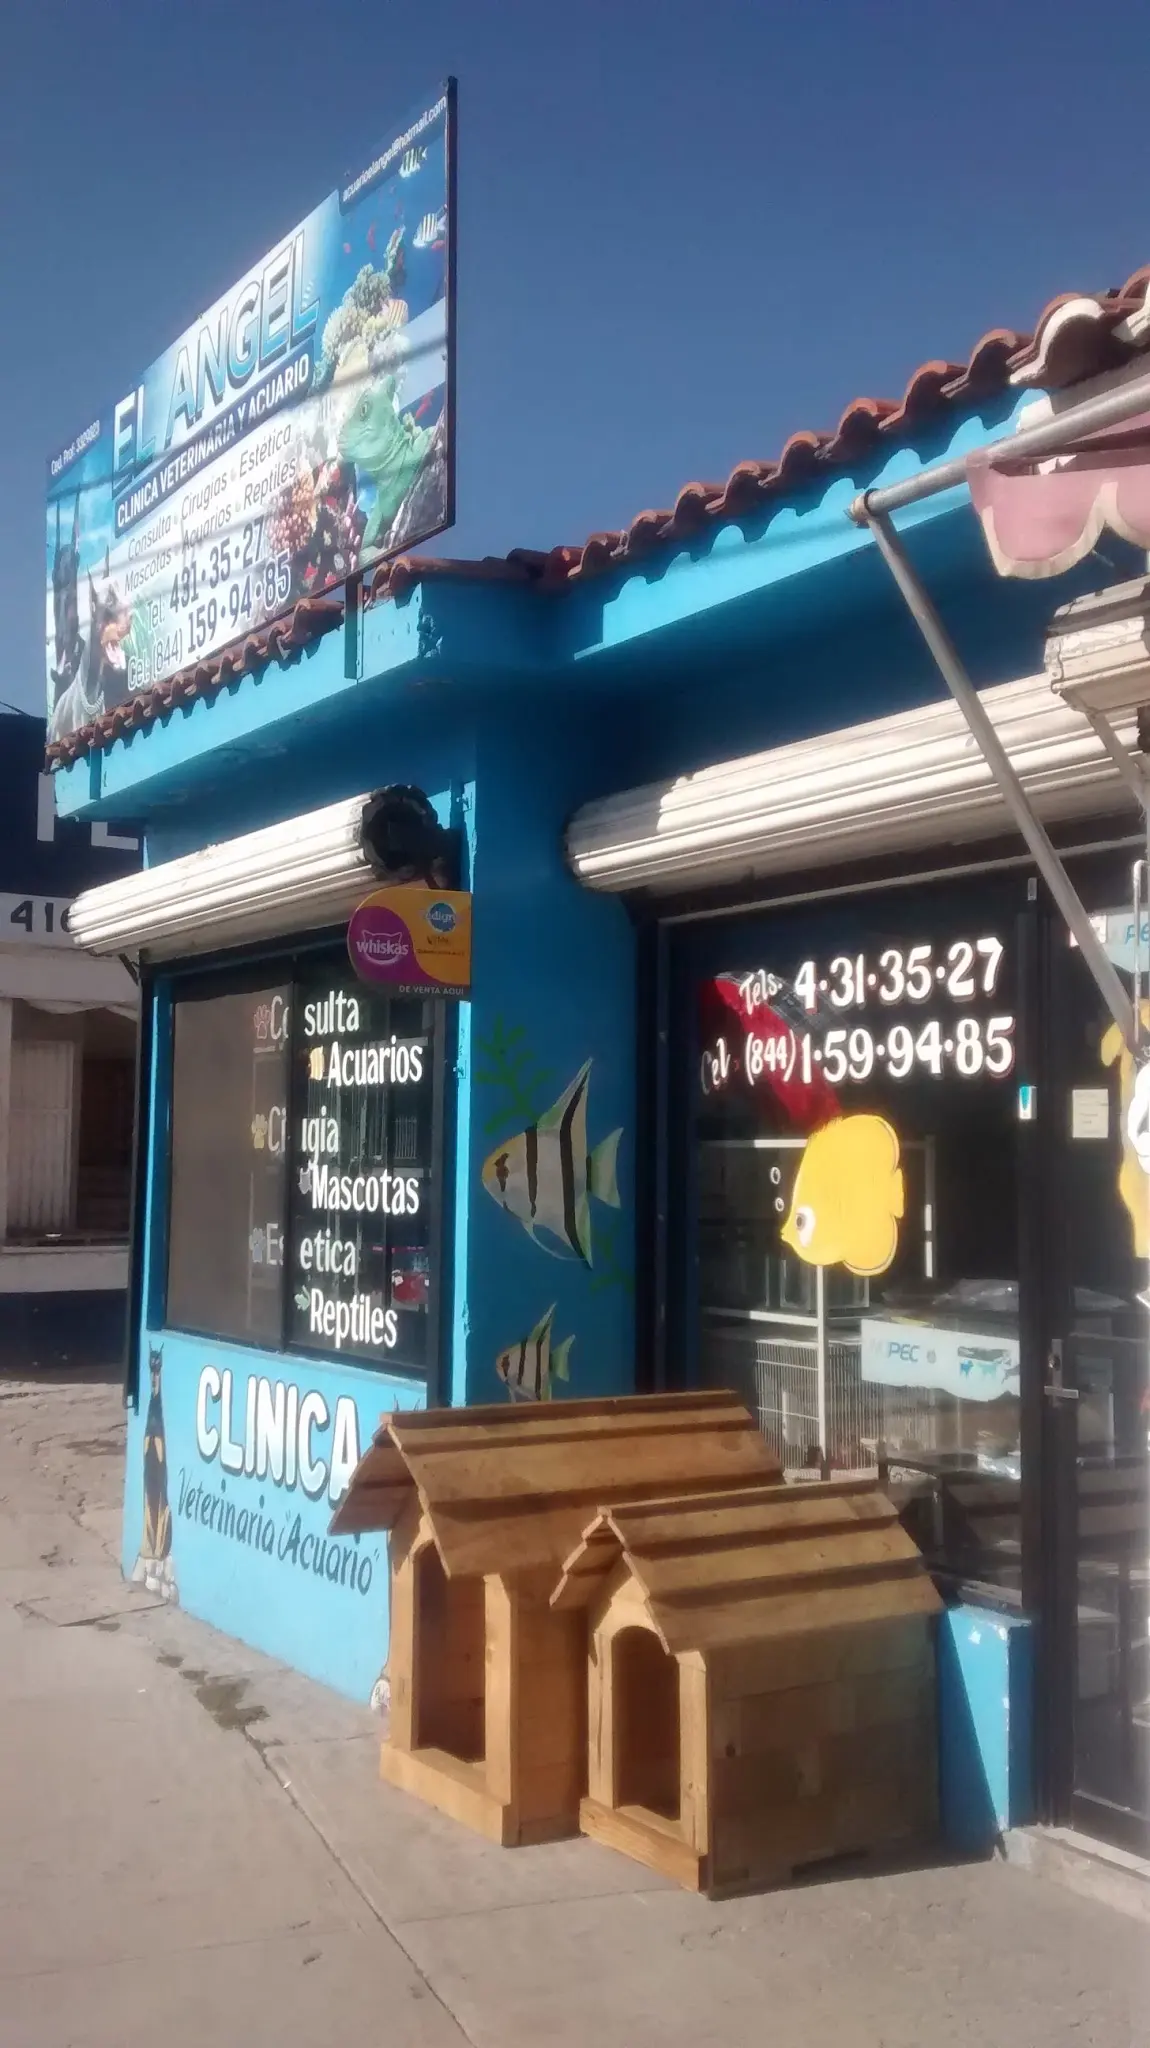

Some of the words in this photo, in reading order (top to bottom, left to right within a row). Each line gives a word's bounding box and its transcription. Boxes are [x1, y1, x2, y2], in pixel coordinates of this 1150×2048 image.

[114, 383, 156, 474] EL
[164, 229, 320, 450] ANGEL
[117, 476, 159, 528] CLINICA
[160, 414, 235, 493] VETERINARIA
[237, 402, 247, 431] Y
[248, 353, 309, 421] ACUARIO
[125, 549, 172, 596] Mascotas
[182, 502, 232, 552] Acuarios
[243, 457, 297, 511] Reptiles
[128, 514, 172, 562] Consulta
[151, 627, 184, 681] (844)
[356, 938, 409, 956] whiskas
[398, 985, 410, 993] DE
[412, 985, 441, 995] VENTA
[327, 1034, 423, 1089] Acuarios
[745, 1028, 797, 1087] (844)
[311, 1164, 420, 1216] Mascotas
[310, 1287, 398, 1349] Reptiles
[197, 1364, 361, 1510] CLINICA
[177, 1467, 276, 1556] Veterinaria
